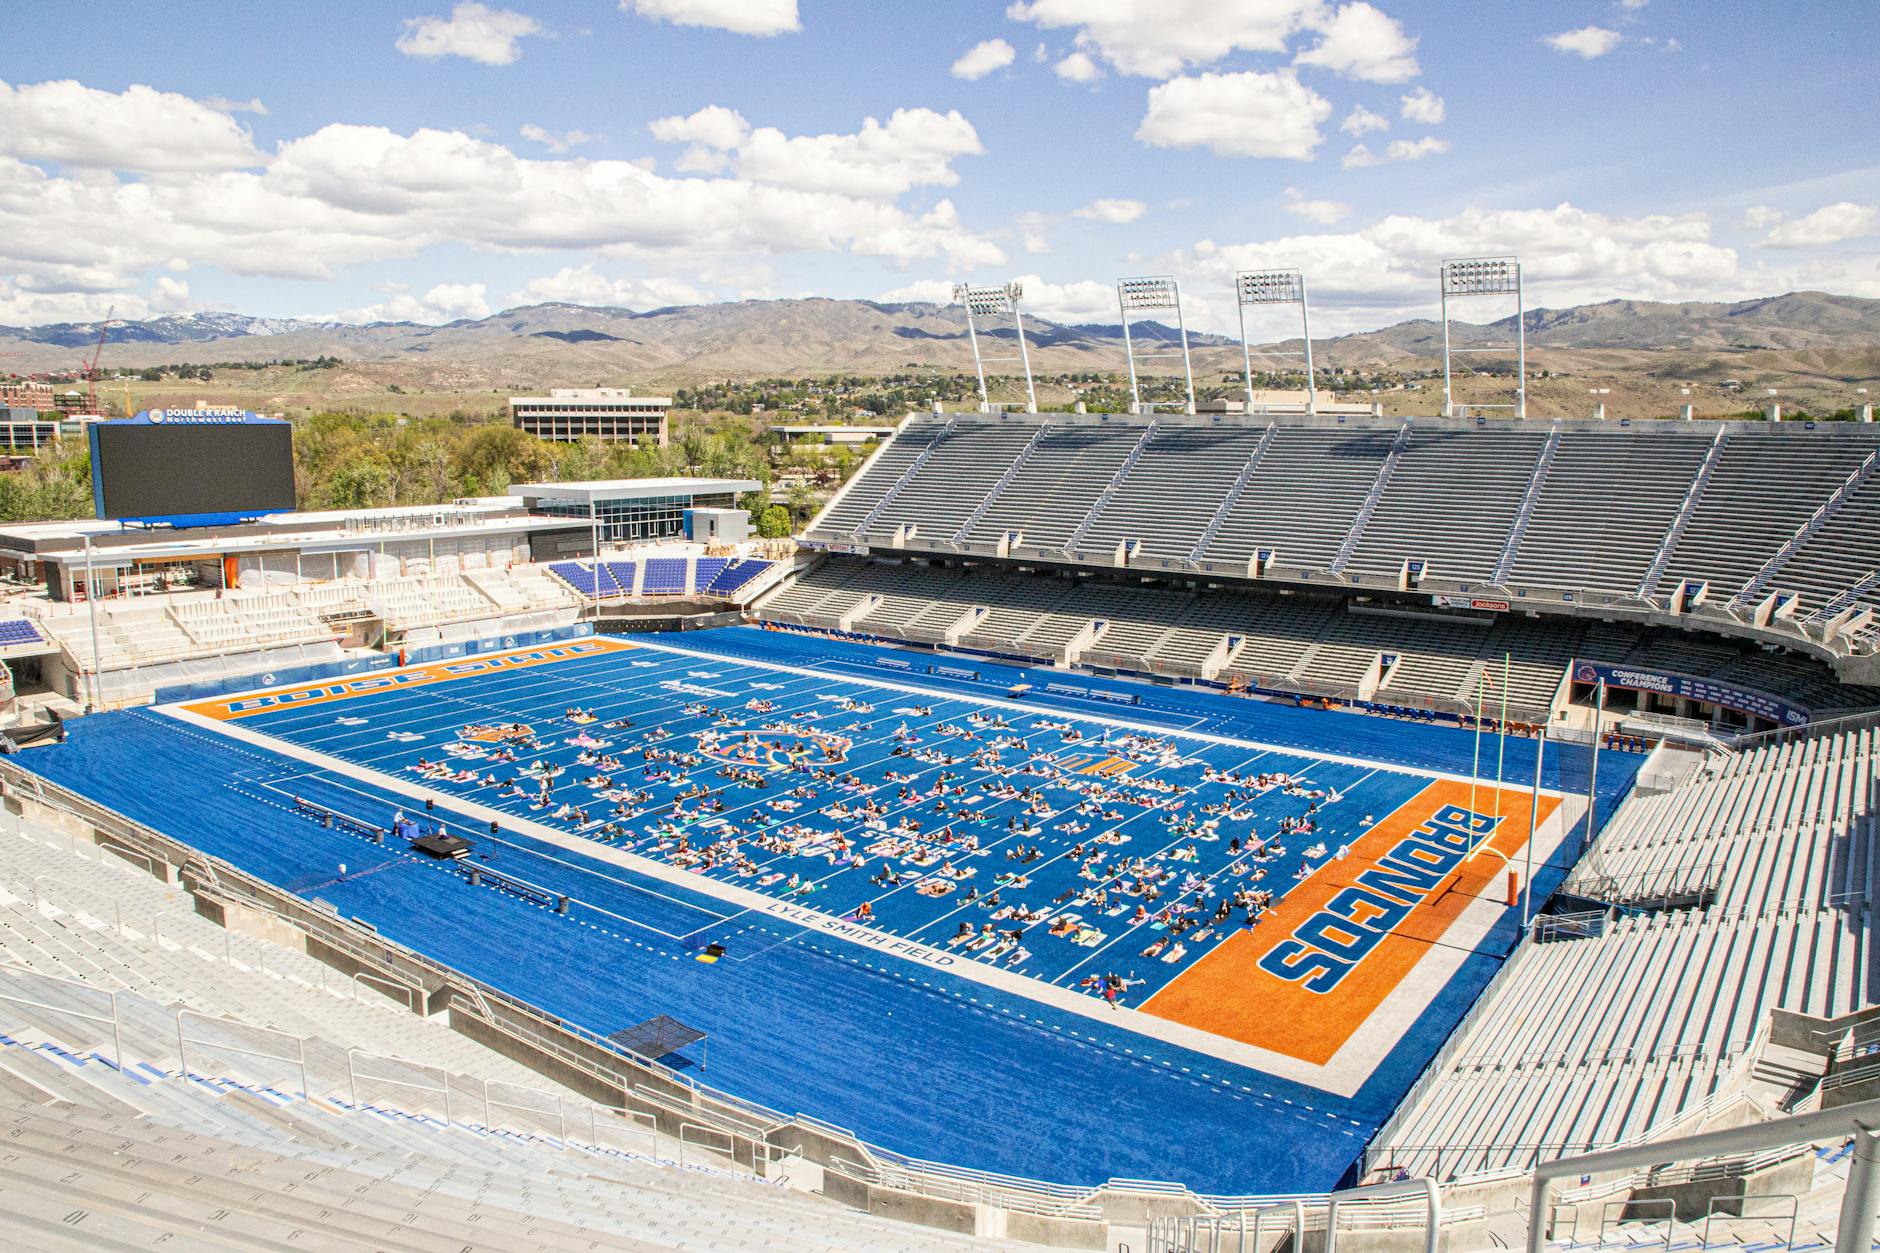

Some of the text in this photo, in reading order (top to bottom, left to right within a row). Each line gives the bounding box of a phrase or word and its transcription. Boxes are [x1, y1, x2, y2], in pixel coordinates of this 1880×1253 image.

[213, 409, 246, 417] RANCH
[1475, 600, 1506, 610] Jacksons
[228, 643, 606, 713] BOISE STATE
[1611, 670, 1669, 684] CONFERENCE
[1620, 678, 1673, 692] CHAMPIONS
[1256, 804, 1507, 994] BRONCOS
[767, 903, 955, 967] LYLE SMITH FIELD
[62, 1210, 90, 1225] 10
